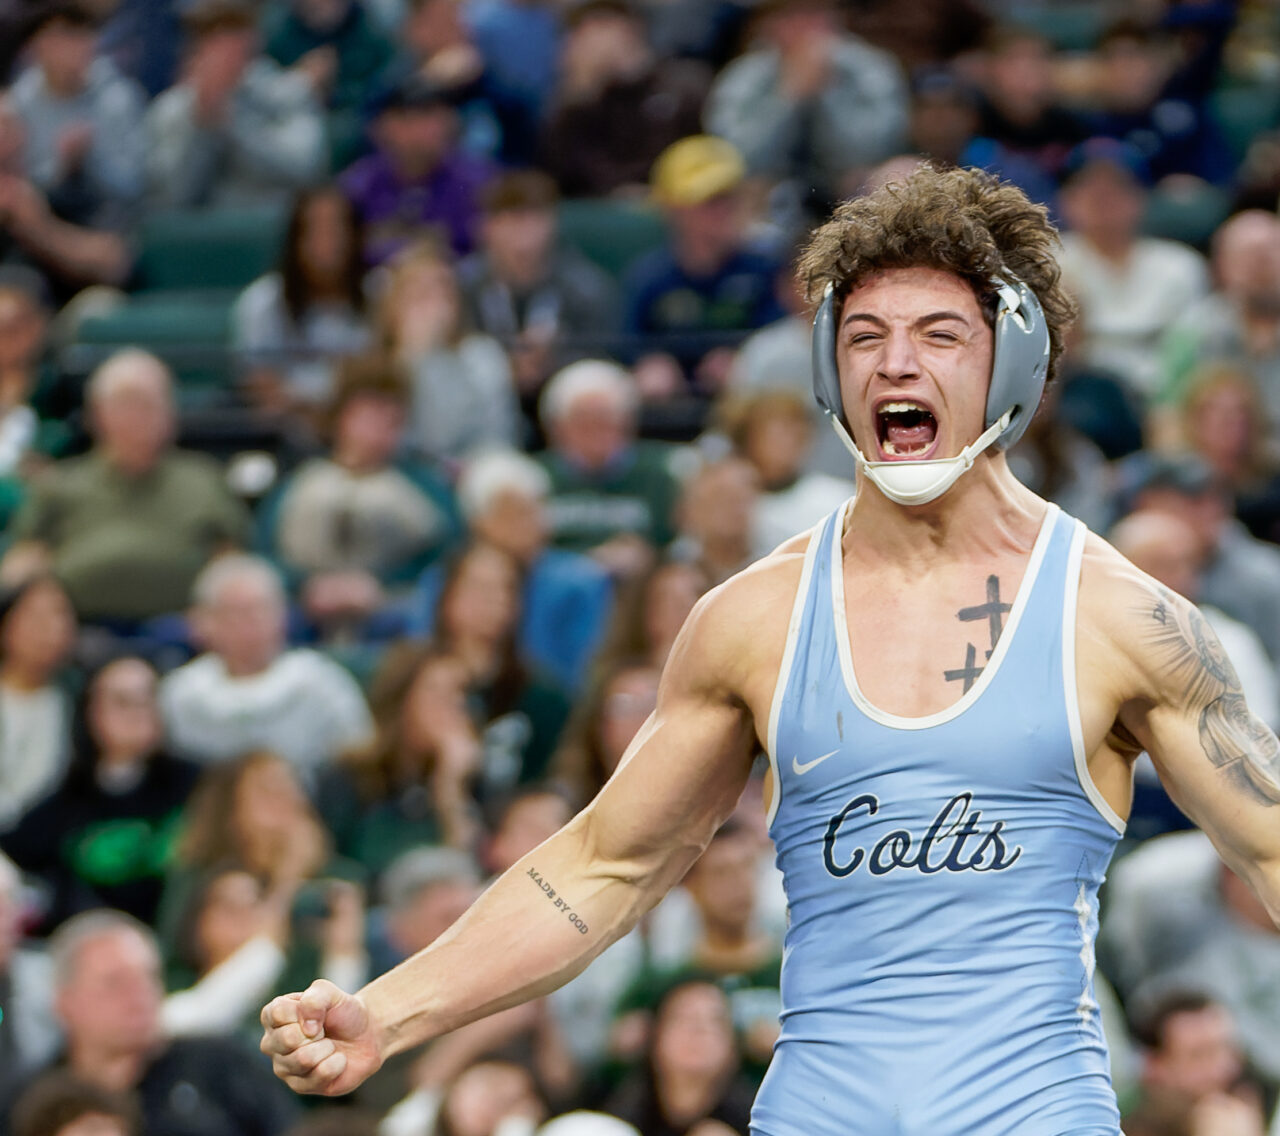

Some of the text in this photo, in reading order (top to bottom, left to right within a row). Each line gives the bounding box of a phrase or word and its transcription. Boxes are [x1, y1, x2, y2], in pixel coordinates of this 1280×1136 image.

[823, 790, 1022, 878] Colts
[526, 867, 589, 935] MADE BY GOD
